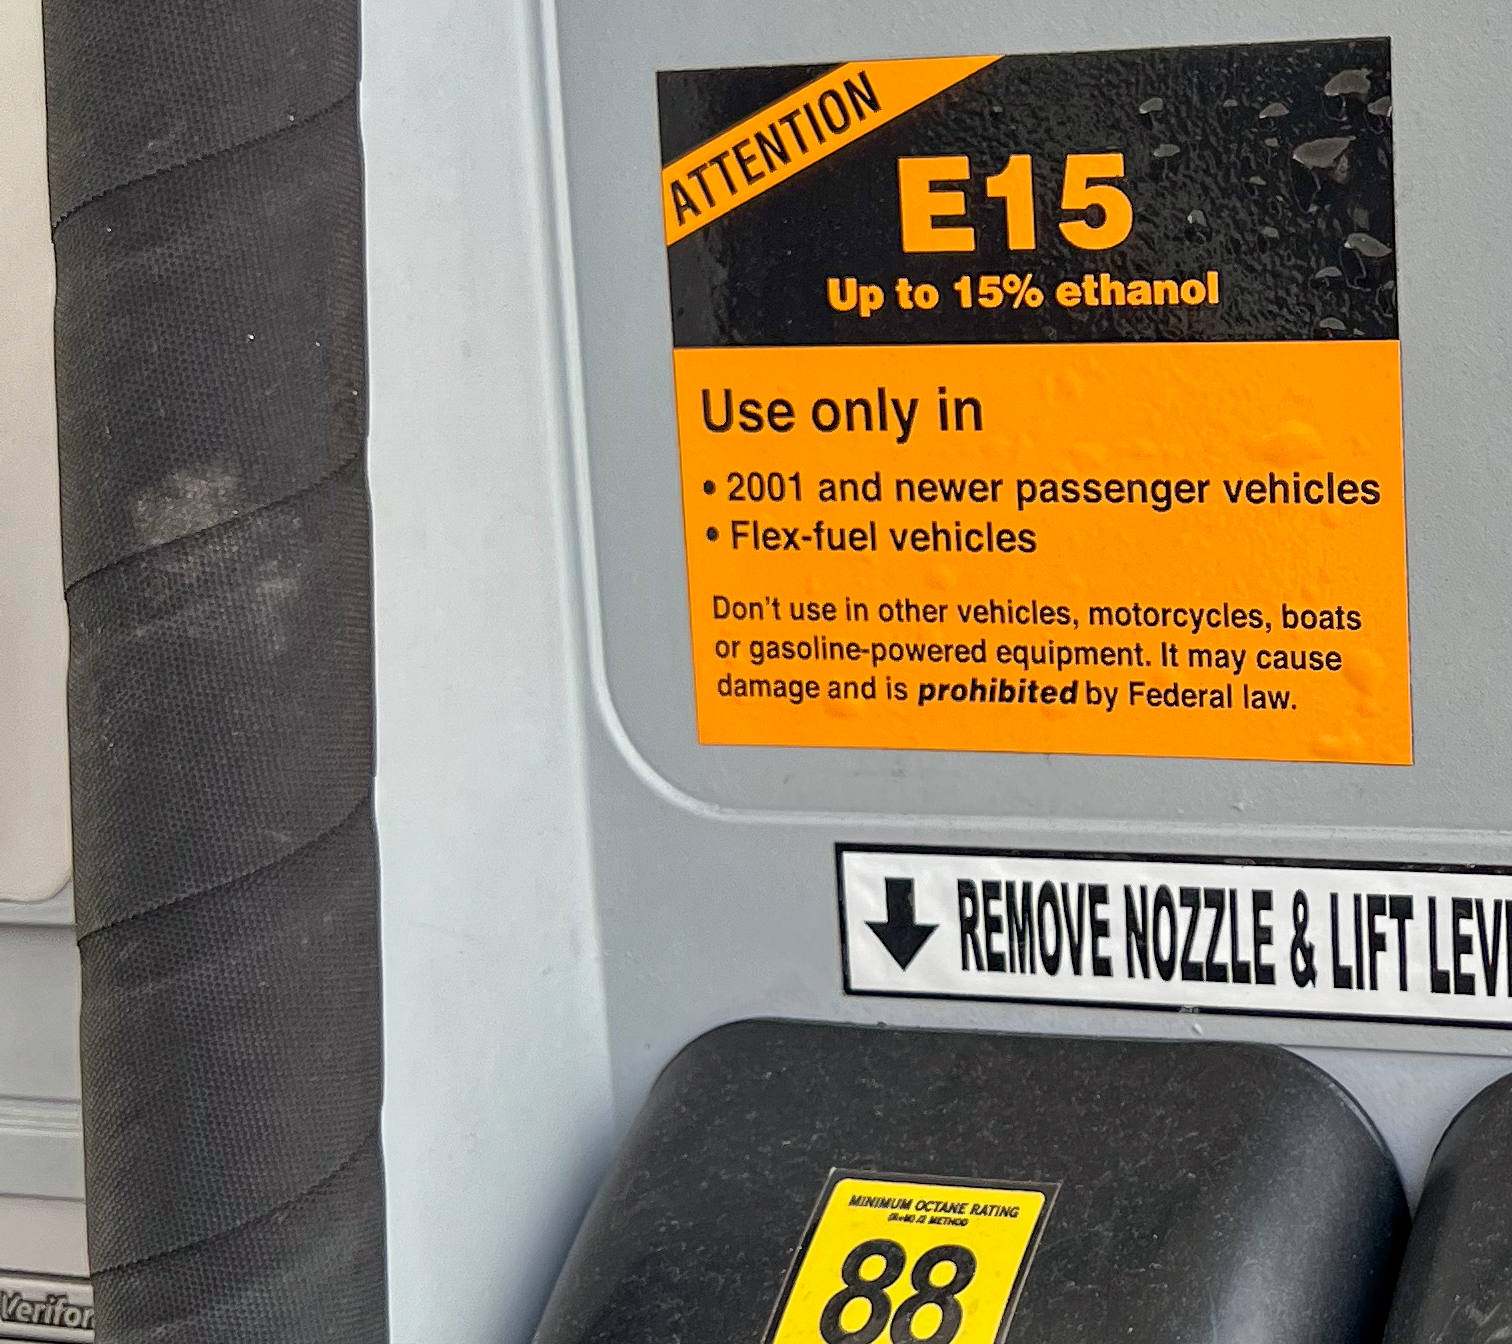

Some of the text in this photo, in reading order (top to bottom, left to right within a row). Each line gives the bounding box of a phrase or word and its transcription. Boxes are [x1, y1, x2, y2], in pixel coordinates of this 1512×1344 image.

[668, 69, 882, 227] ATTENTION
[899, 153, 1132, 252] E15
[828, 272, 1218, 317] Up to 15% ethanol
[702, 386, 982, 444] Use only in
[728, 472, 1380, 512] 2001 and newer passenger vehicles
[732, 520, 1036, 553] Flex-fuel vehicles
[713, 595, 1361, 634] Don't use in other vehicles, motorcycles, boats
[716, 636, 1342, 675] or gasoline-powered equipment. It may cause
[718, 673, 1296, 712] damage and is prohibited by Federal law.
[958, 879, 1113, 976] REMOVE
[1124, 885, 1275, 985] NOZZLE
[1291, 890, 1316, 987] &
[1331, 893, 1413, 991] LIFT
[848, 1194, 914, 1211] MINIMUM
[914, 1199, 969, 1215] OCTANE
[970, 1203, 1020, 1219] RATING
[0, 1290, 94, 1330] Verifon
